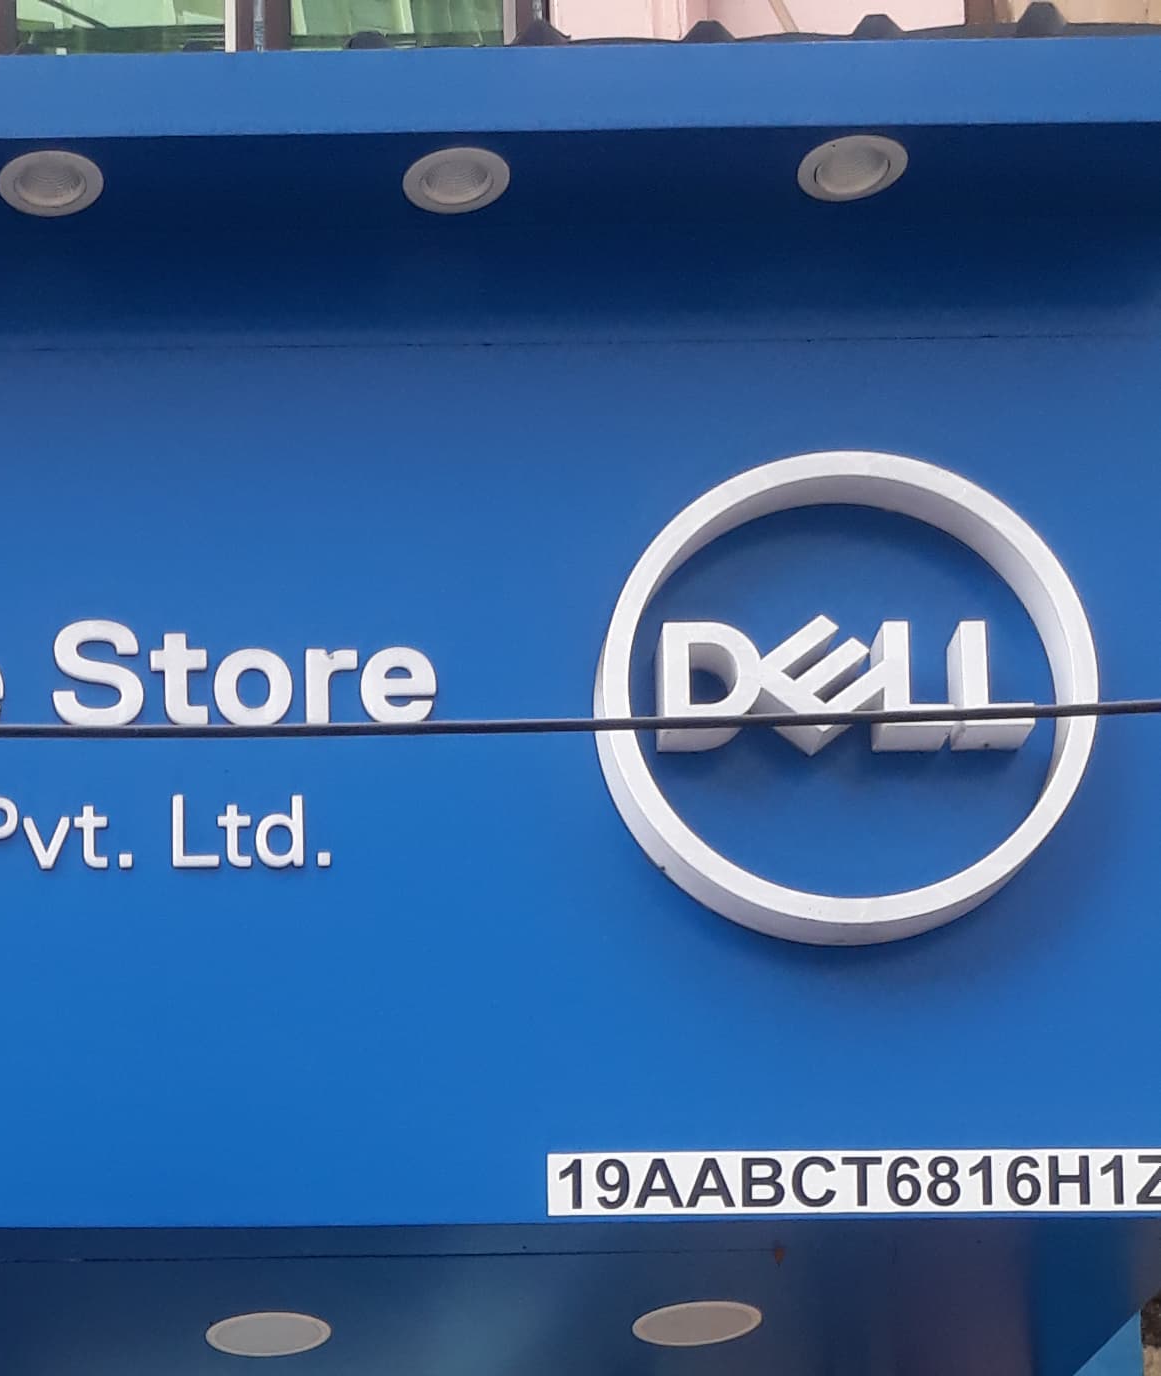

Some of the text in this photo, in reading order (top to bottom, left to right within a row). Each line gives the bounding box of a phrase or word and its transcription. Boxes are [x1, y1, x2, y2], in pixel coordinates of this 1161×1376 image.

[51, 617, 439, 730] Store
[654, 613, 1035, 756] DELL
[170, 793, 334, 870] Ltd.
[557, 1153, 1161, 1210] 19AABCT6816H1Z
